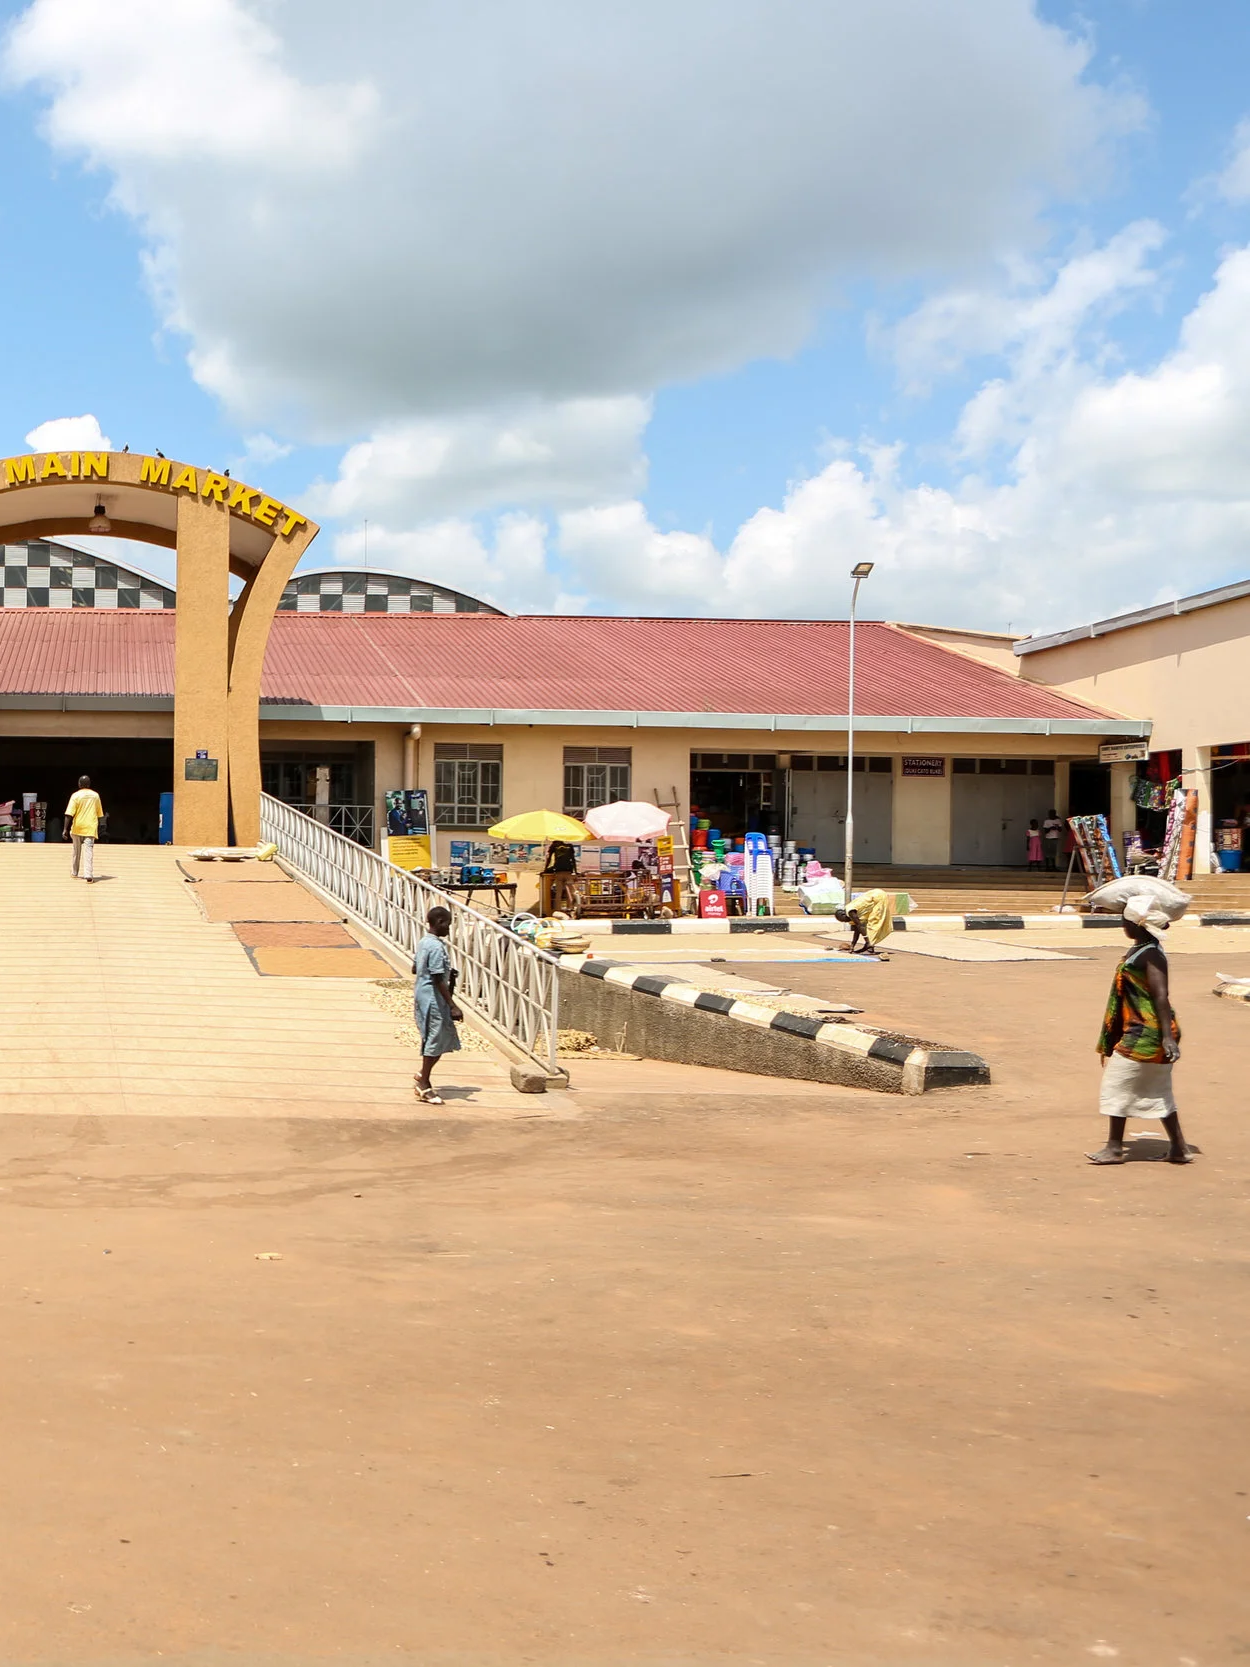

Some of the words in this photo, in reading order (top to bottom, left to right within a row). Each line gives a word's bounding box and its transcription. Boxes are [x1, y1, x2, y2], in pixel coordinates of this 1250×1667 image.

[4, 451, 109, 485] MAIN
[139, 456, 307, 537] MARKET
[705, 904, 724, 912] airtel
